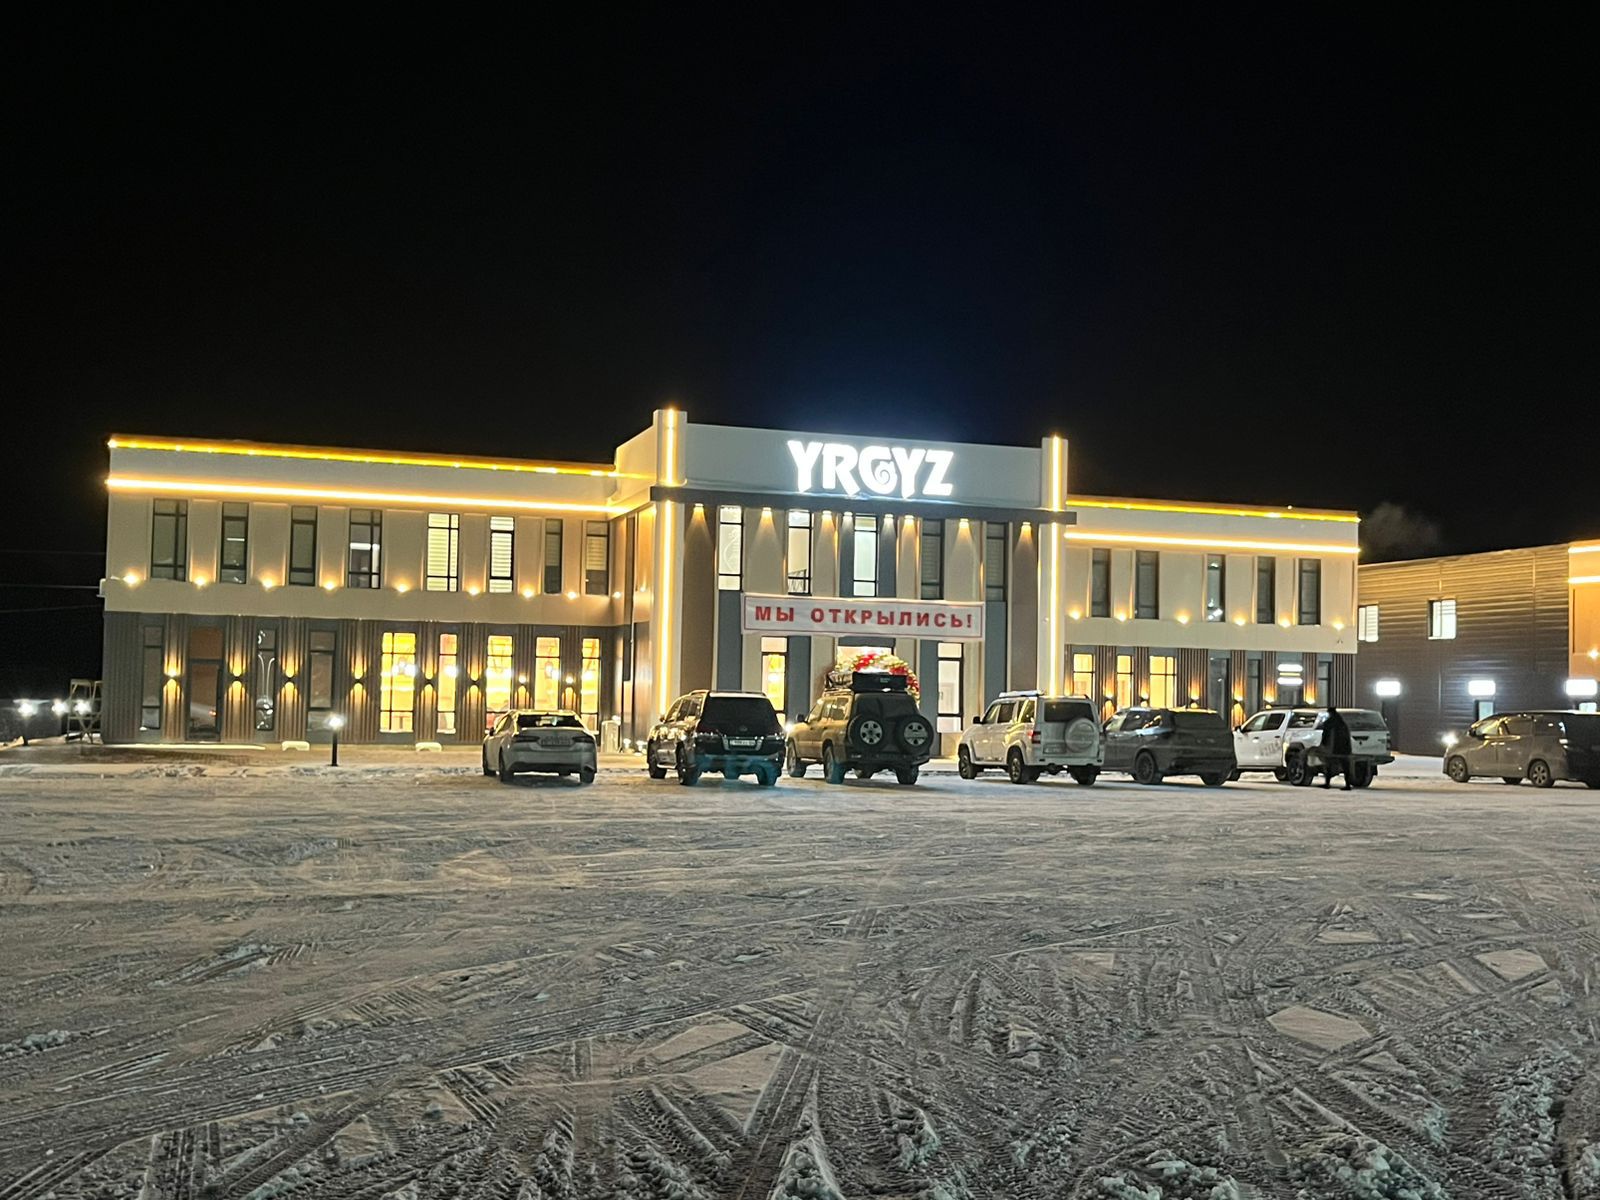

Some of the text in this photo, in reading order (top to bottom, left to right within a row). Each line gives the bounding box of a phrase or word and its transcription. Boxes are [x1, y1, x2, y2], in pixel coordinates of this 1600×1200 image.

[787, 440, 954, 499] YRGYZ
[755, 606, 973, 628] МЫ ОТКРЫЛИСЬ!
